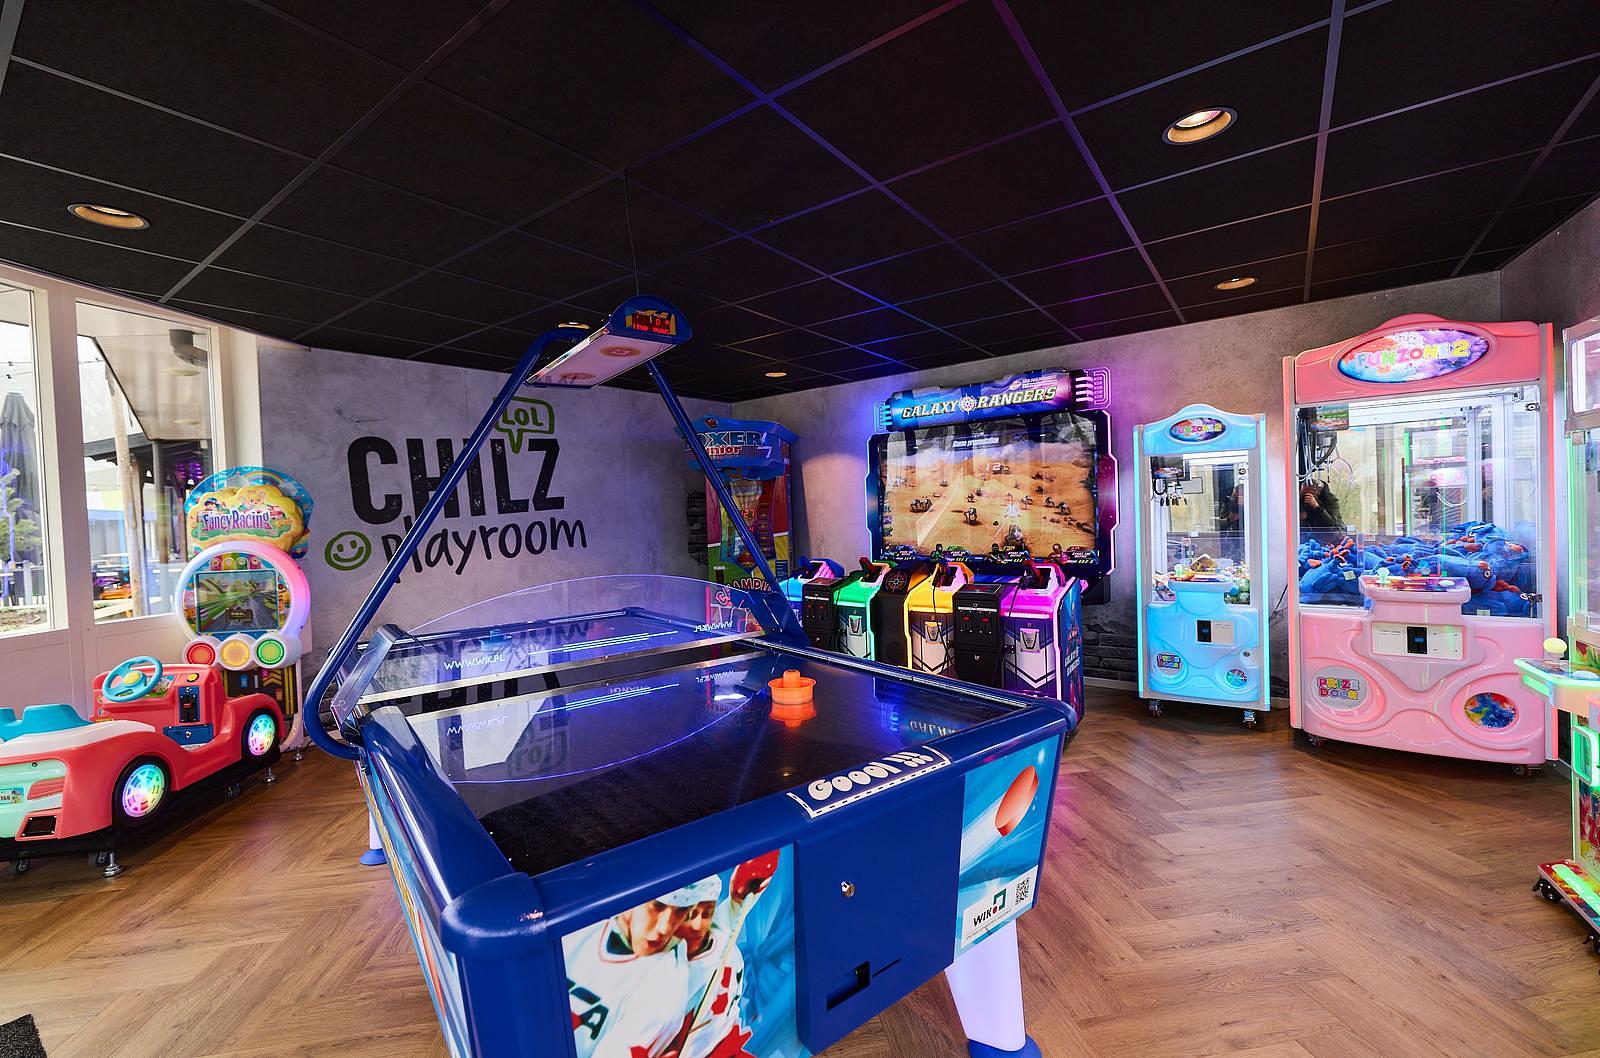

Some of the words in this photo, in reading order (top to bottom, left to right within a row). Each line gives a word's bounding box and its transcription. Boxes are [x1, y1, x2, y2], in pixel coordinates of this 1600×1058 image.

[1451, 339, 1471, 357] 2
[901, 398, 959, 419] GALAXY
[976, 386, 1058, 409] RANGERS
[500, 405, 544, 427] LOL
[347, 436, 565, 525] CHILZ
[380, 516, 588, 583] playroom
[443, 653, 505, 671] WWW.WIK.PL
[1317, 677, 1360, 691] PRIZE
[1319, 688, 1359, 701] DOOR
[972, 906, 993, 927] WIK
